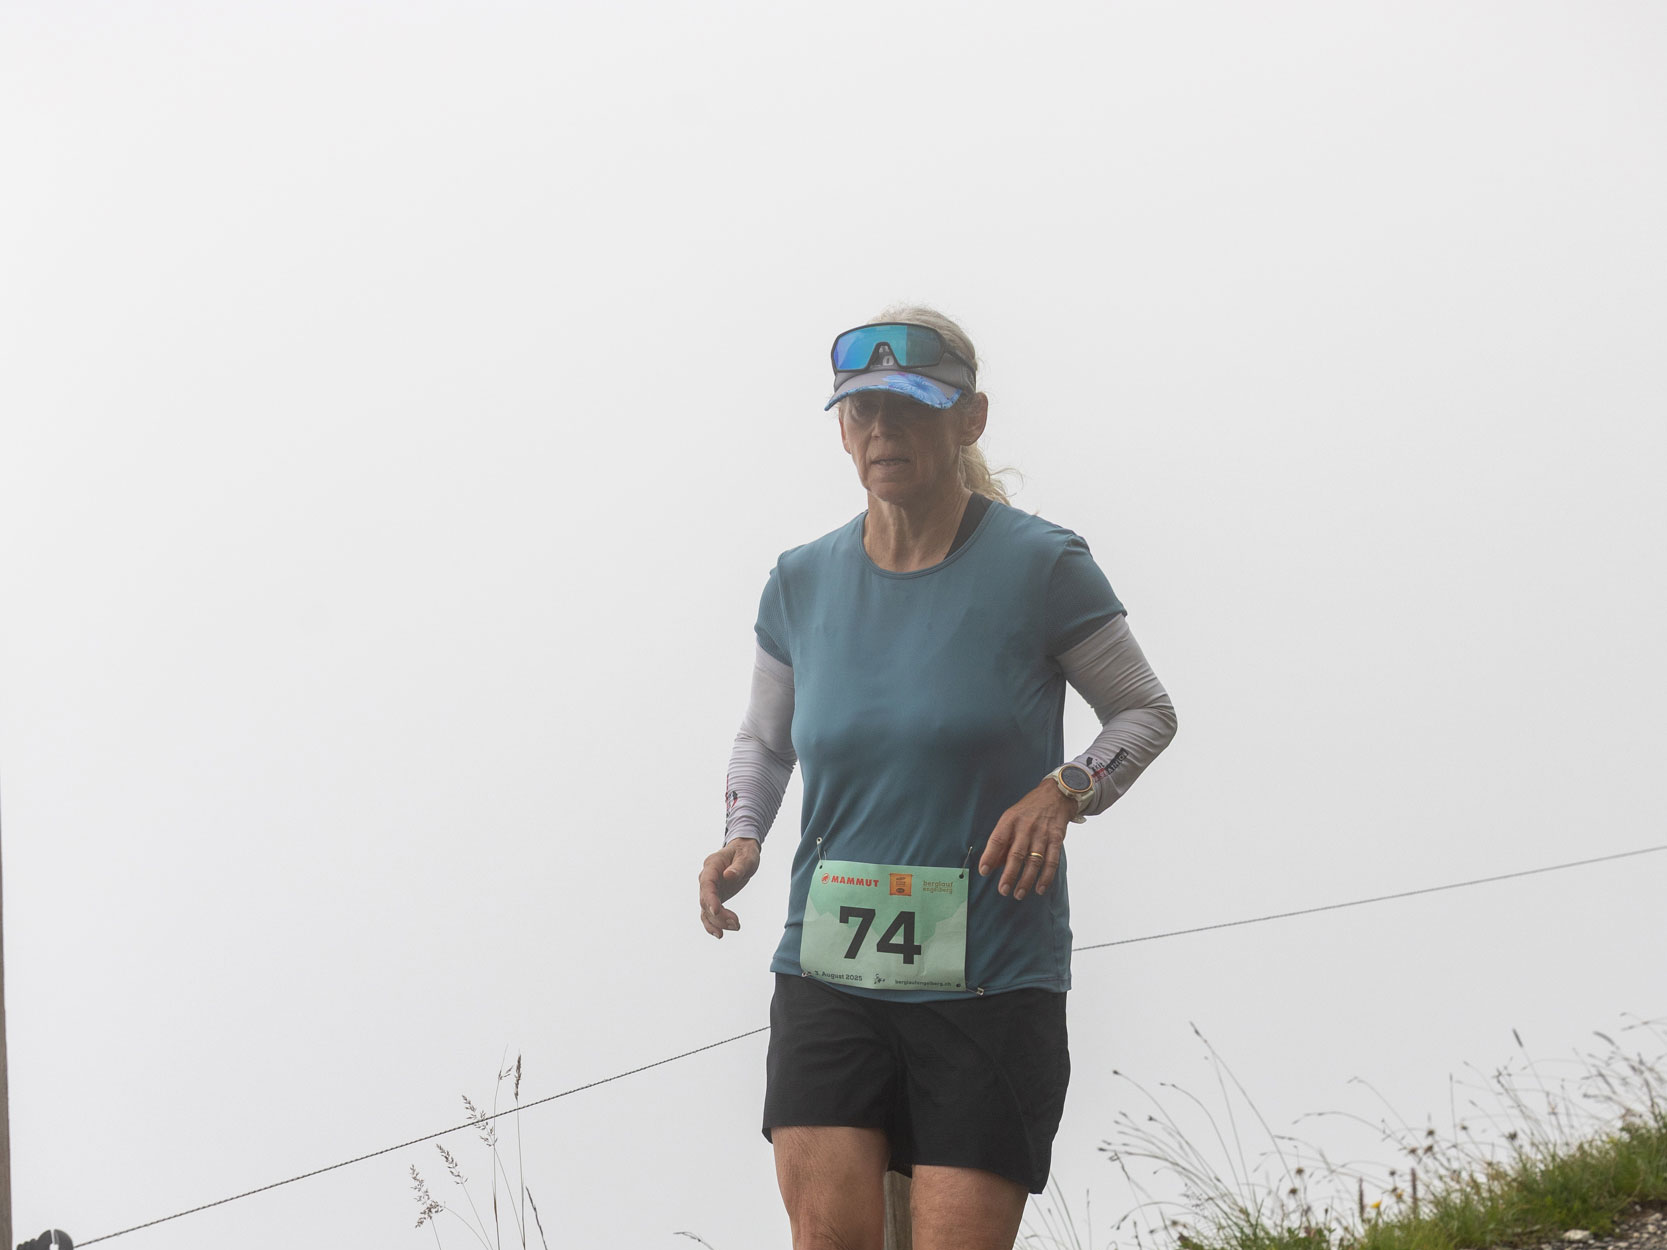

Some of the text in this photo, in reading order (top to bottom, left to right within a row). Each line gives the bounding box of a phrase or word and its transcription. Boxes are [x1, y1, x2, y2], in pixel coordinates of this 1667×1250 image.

[831, 875, 880, 887] MAMMUT
[922, 879, 954, 888] berglauf
[839, 905, 922, 965] 74
[821, 971, 845, 980] August
[845, 974, 863, 982] 2025
[894, 978, 952, 986] berglaufengelberg.ch
